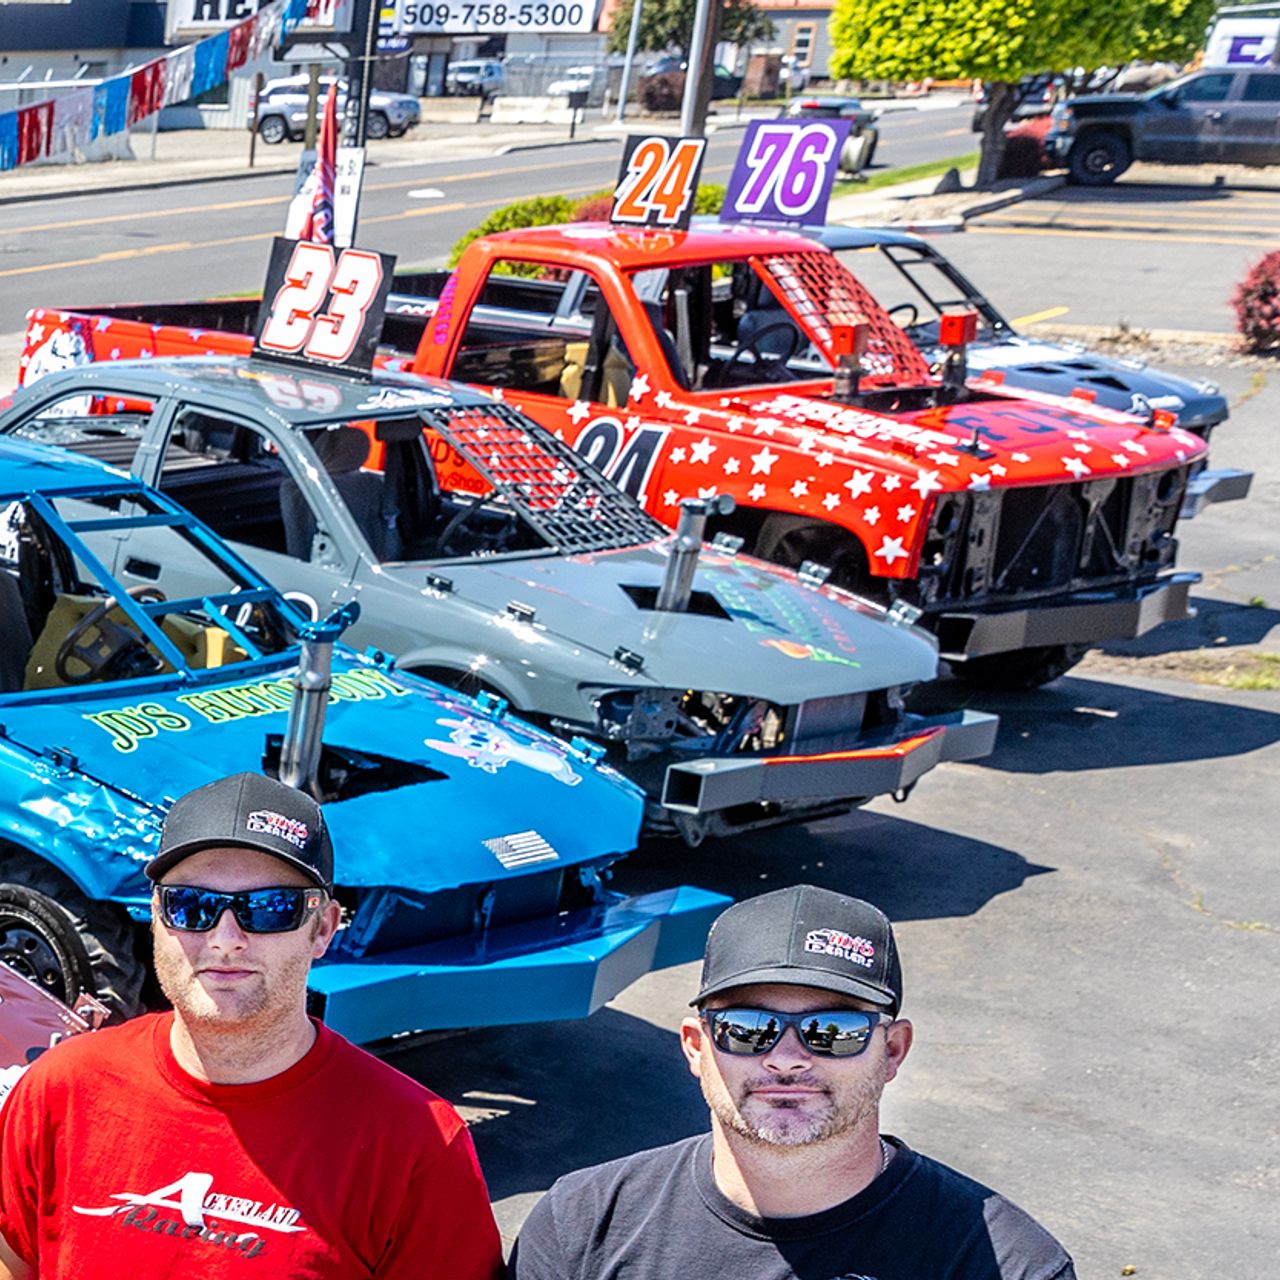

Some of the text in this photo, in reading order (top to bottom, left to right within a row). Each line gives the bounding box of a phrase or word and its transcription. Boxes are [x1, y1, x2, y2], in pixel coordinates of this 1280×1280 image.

[403, 3, 583, 26] 509-758-5300
[611, 136, 706, 224] 24
[735, 123, 838, 217] 76
[259, 241, 383, 363] 23
[83, 701, 190, 753] JD'S
[108, 1171, 307, 1233] ACKERLAND
[113, 1203, 269, 1260] Racing
